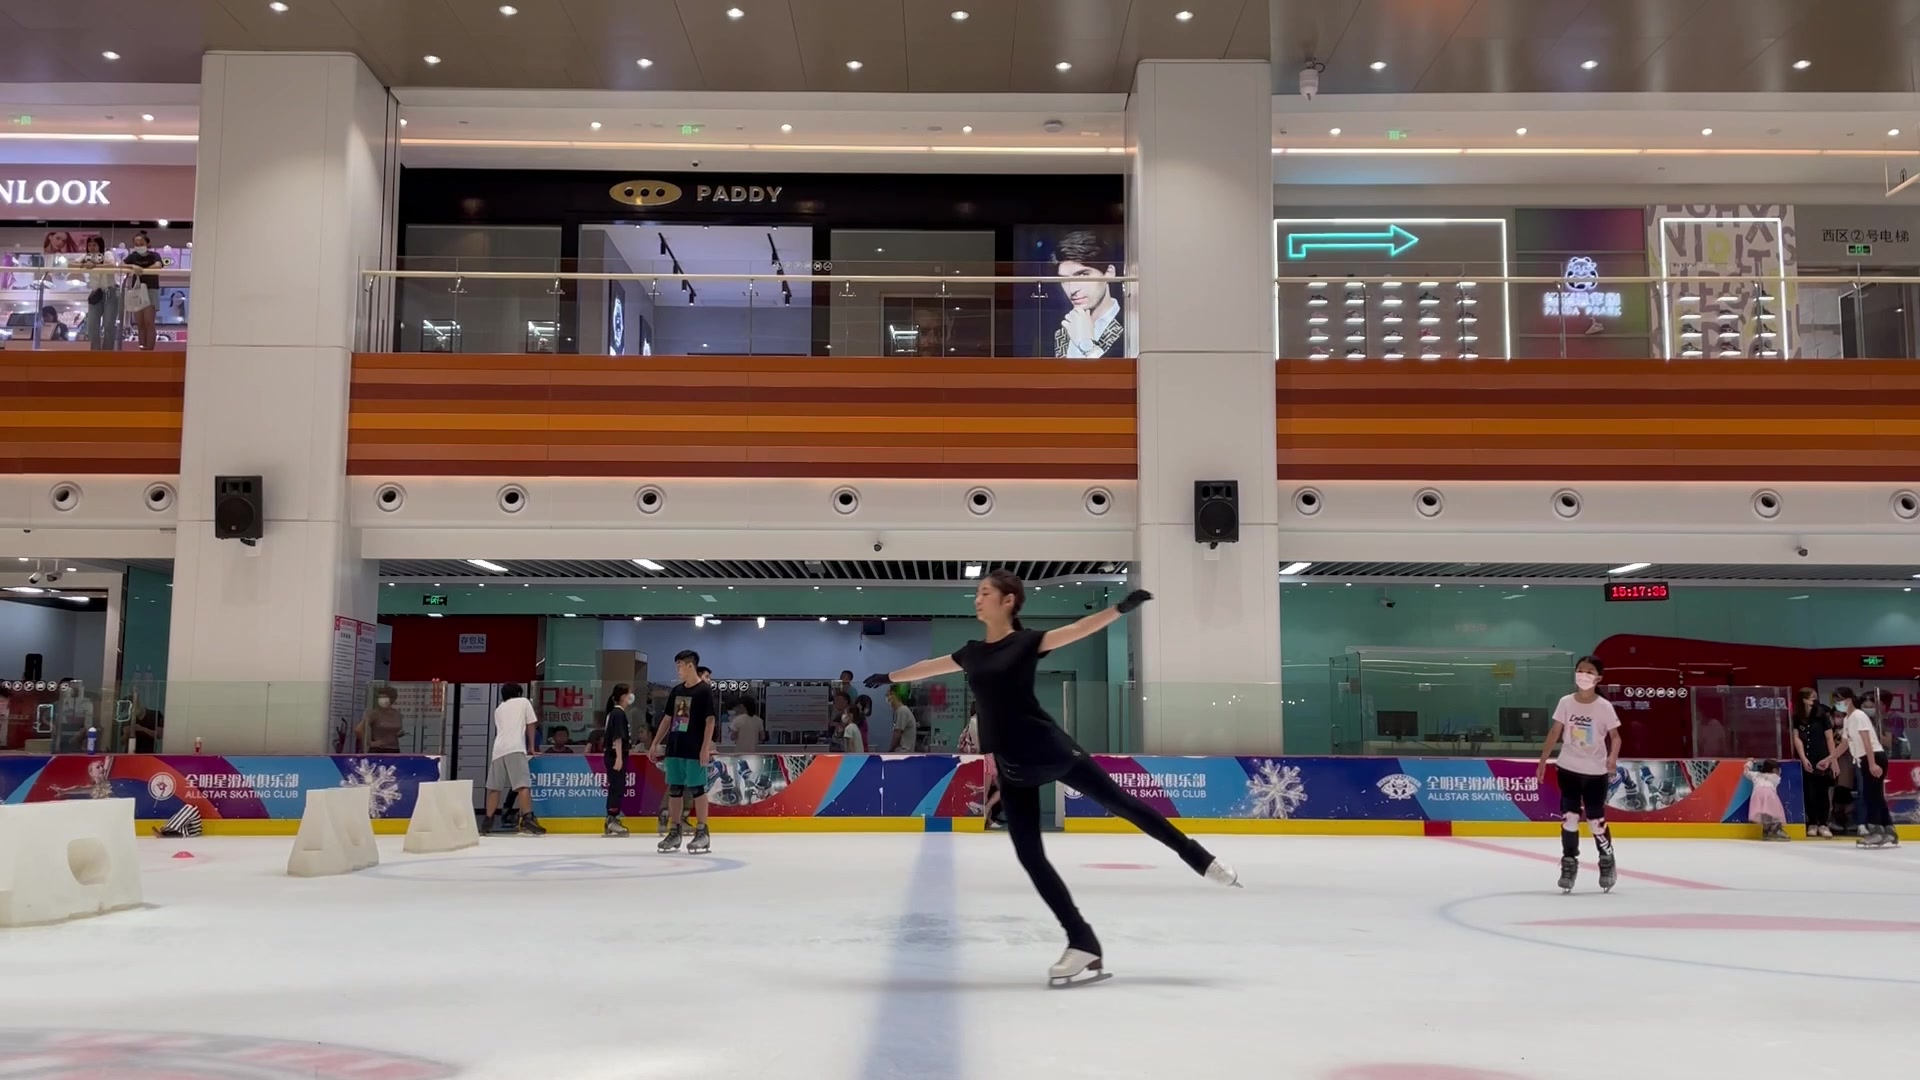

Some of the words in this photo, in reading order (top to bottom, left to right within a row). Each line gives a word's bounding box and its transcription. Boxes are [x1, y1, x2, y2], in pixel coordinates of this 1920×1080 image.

[697, 185, 783, 202] PADDY
[184, 773, 300, 789] 全明星滑冰俱乐部
[1426, 775, 1539, 792] 全明星滑冰俱乐部
[184, 790, 228, 799] ALLSTAR
[229, 790, 274, 799] SKATING
[275, 790, 299, 799] CLUB
[530, 788, 566, 798] LLSTAR
[567, 788, 609, 798] SKATING
[1139, 789, 1181, 798] SKATING
[1181, 789, 1207, 798] CLUB
[1427, 792, 1469, 801] ALLSTAR
[1471, 792, 1512, 802] SKATING
[1514, 792, 1540, 802] CLUB
